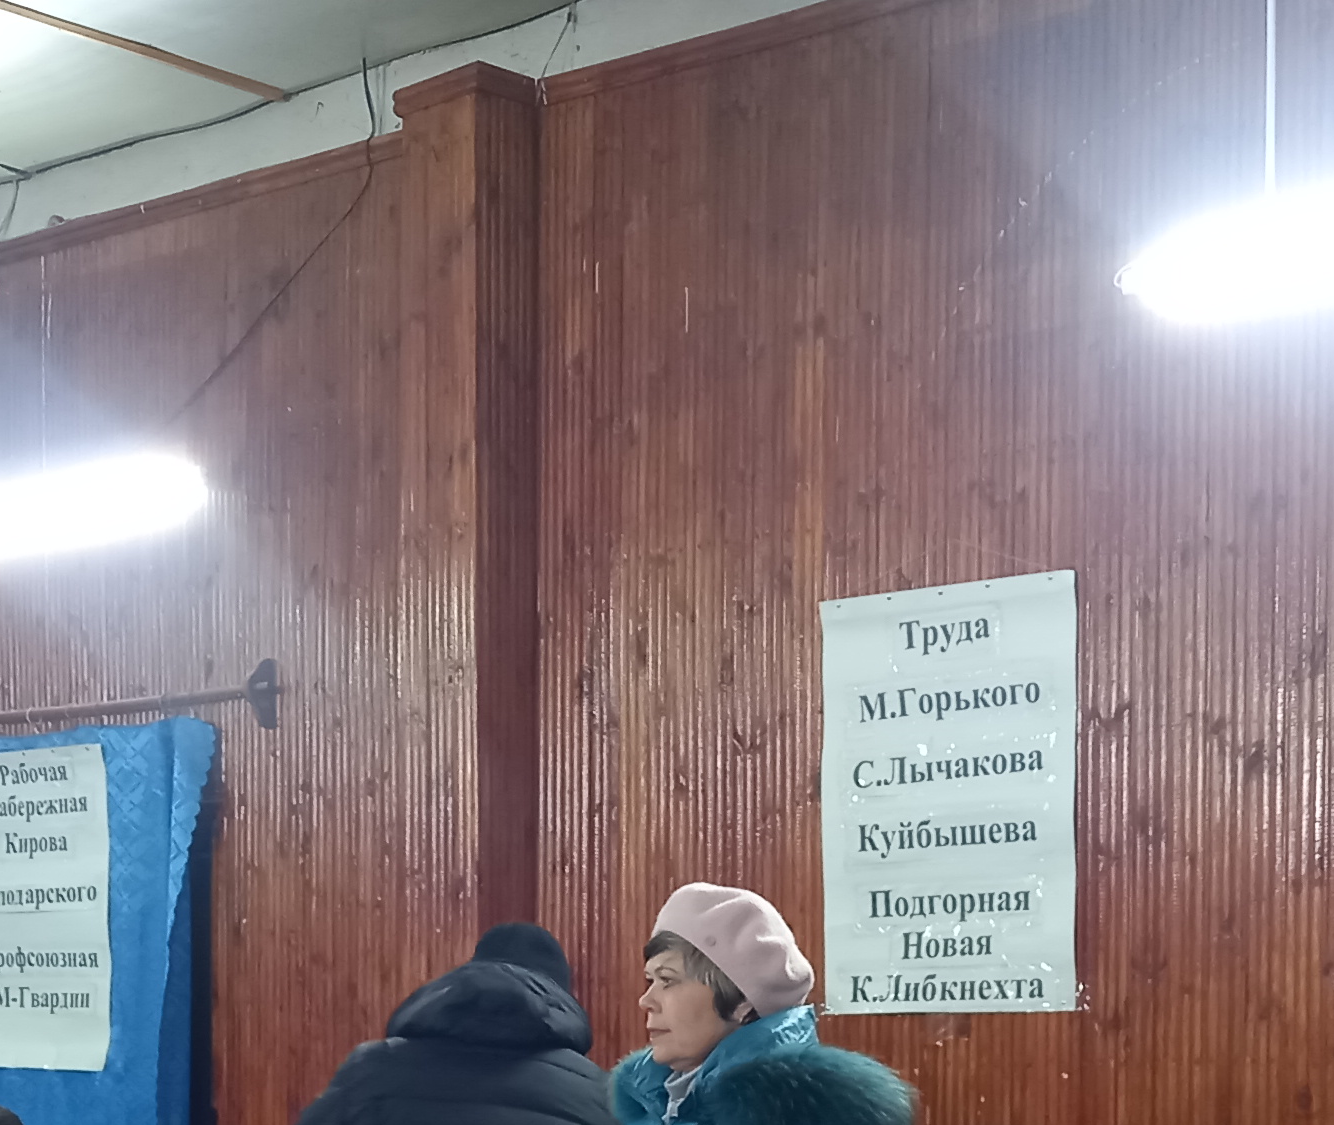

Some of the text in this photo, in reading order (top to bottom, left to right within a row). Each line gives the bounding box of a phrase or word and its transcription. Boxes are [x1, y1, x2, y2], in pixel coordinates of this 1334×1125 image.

[899, 616, 990, 655] Труда
[858, 680, 1040, 723] М.Горького
[853, 748, 1044, 789] С.Лычакова
[5, 832, 68, 859] Кирова
[858, 818, 1037, 858] Куйбышева
[868, 888, 1030, 922] Подгорная
[901, 930, 992, 961] Новая
[851, 973, 1044, 1004] К.Либкнехта
